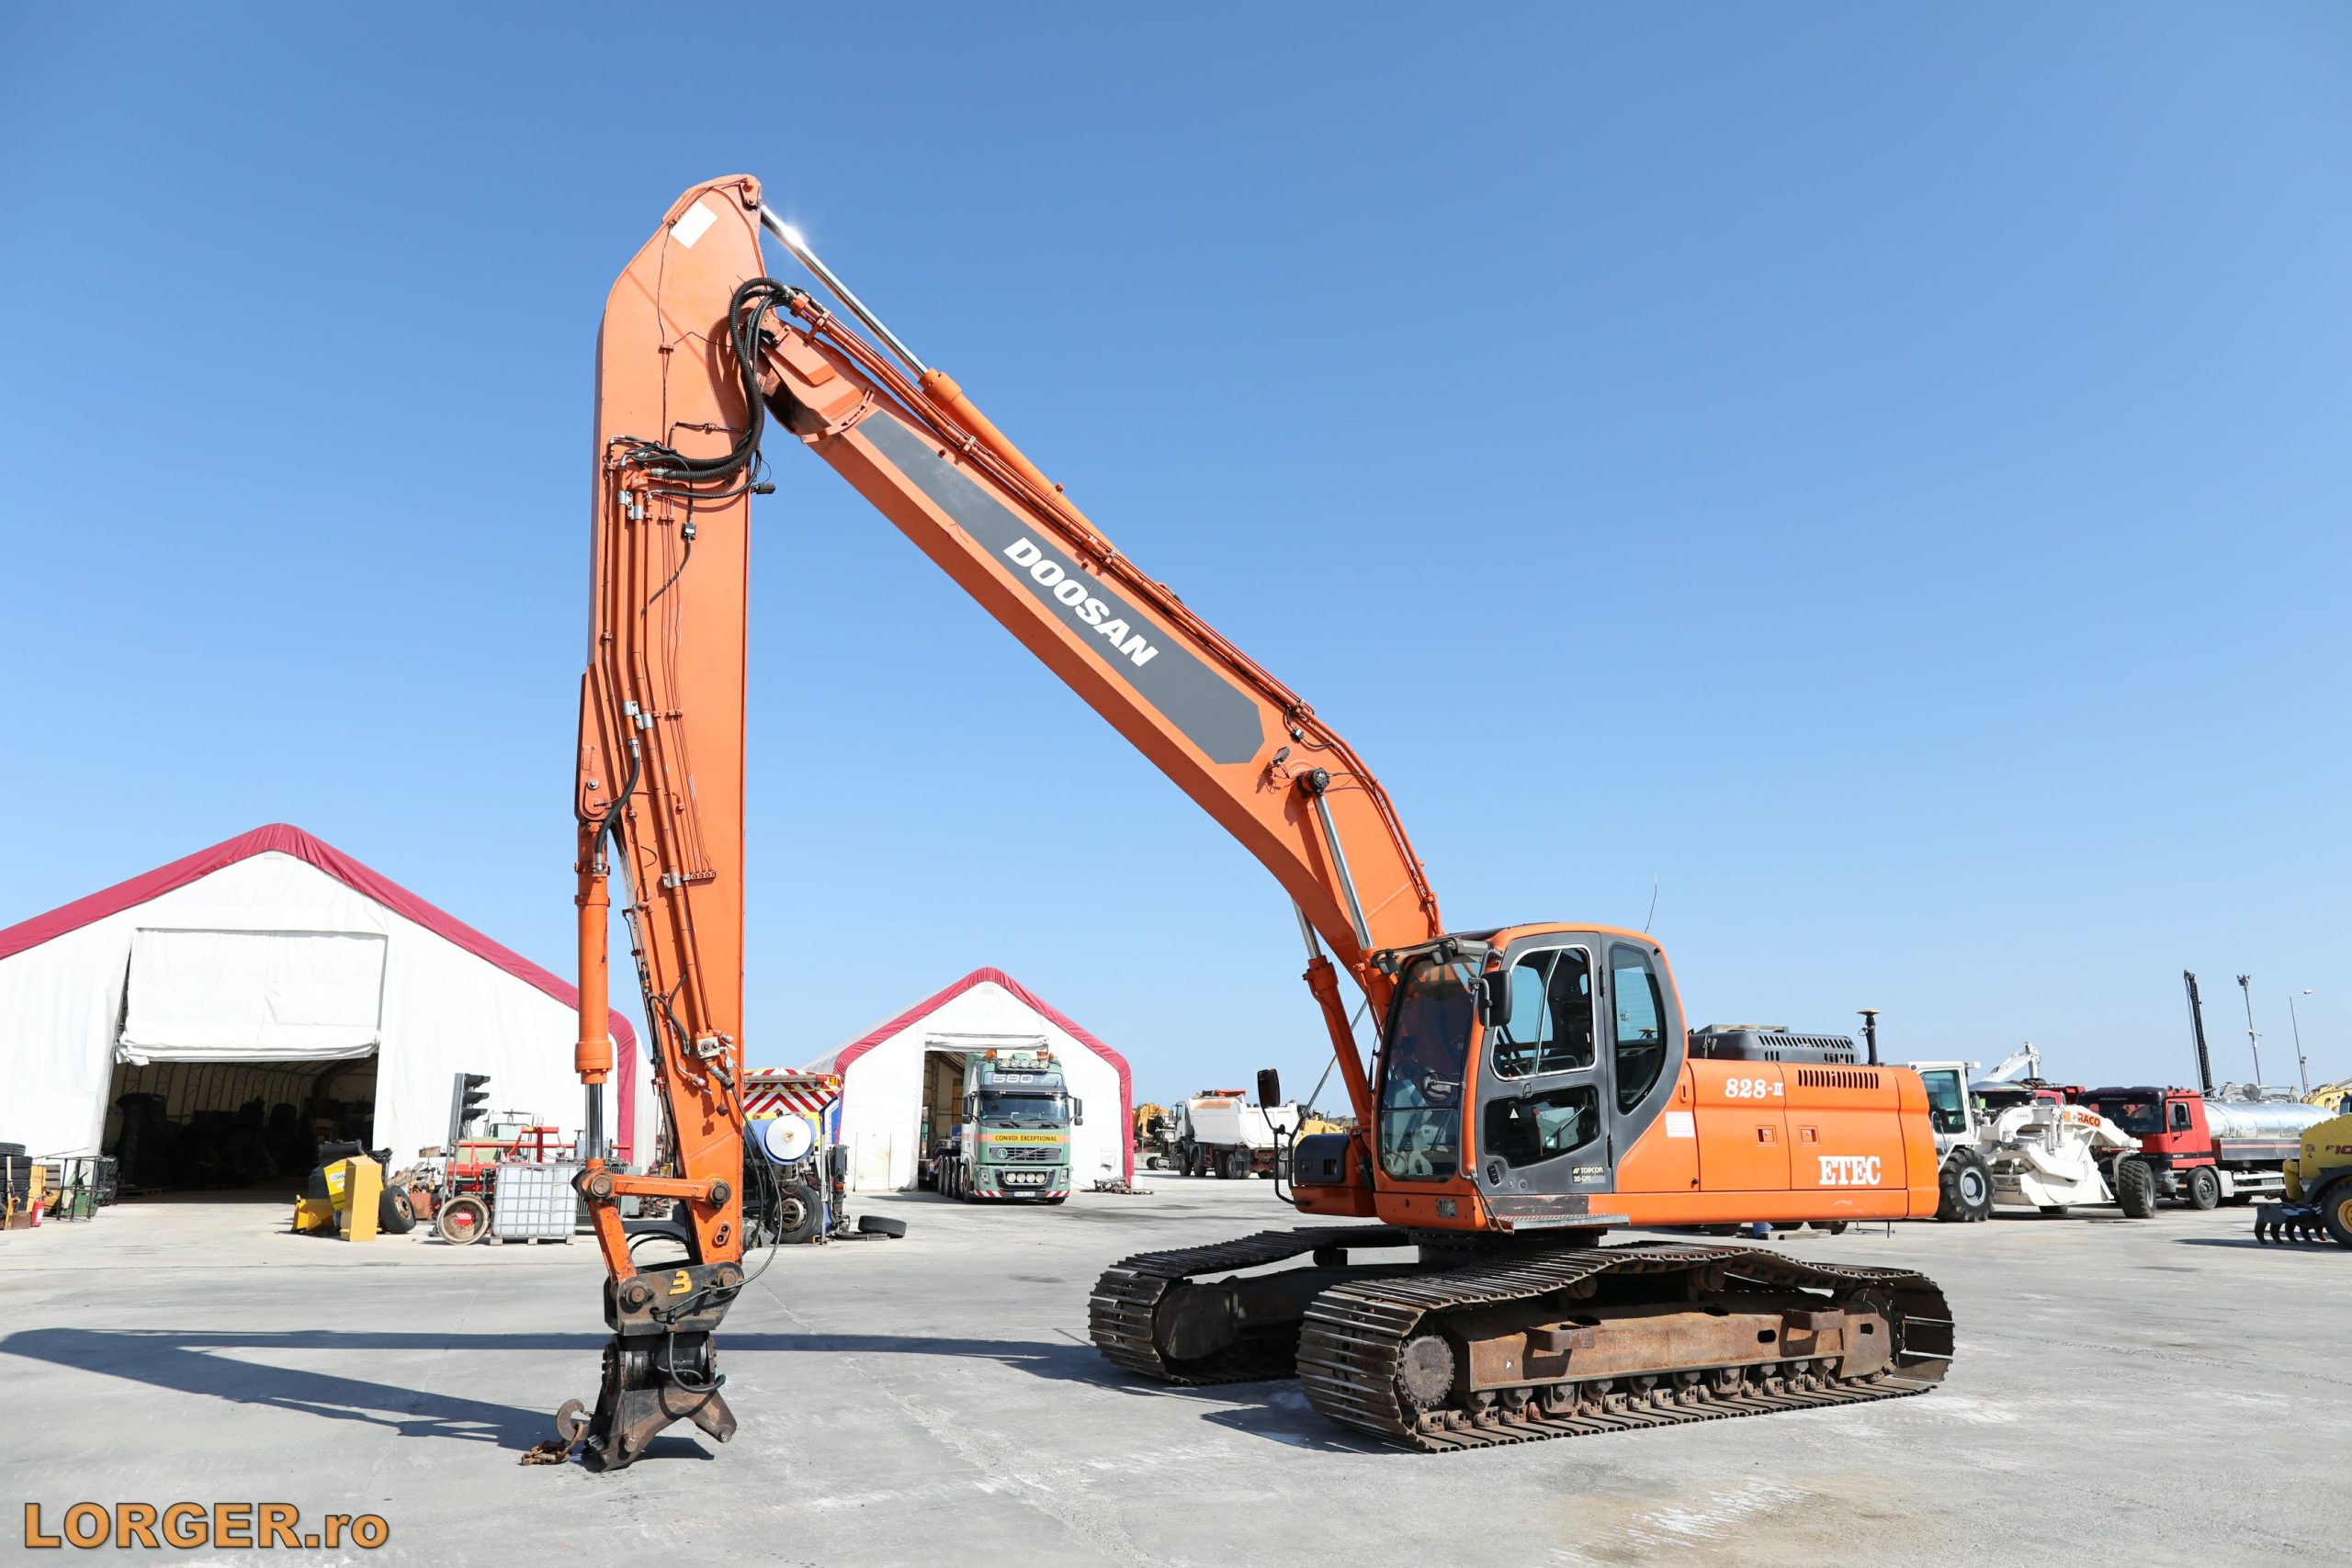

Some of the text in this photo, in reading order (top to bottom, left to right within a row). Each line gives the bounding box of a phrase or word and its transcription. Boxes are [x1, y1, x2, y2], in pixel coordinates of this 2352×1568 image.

[1003, 537, 1159, 667] DOOSAN
[992, 1074, 1034, 1083] 580
[1724, 1078, 1783, 1099] 828-II
[2077, 1112, 2101, 1127] RACO
[1818, 1156, 1881, 1186] ETEC
[669, 1269, 692, 1295] 3
